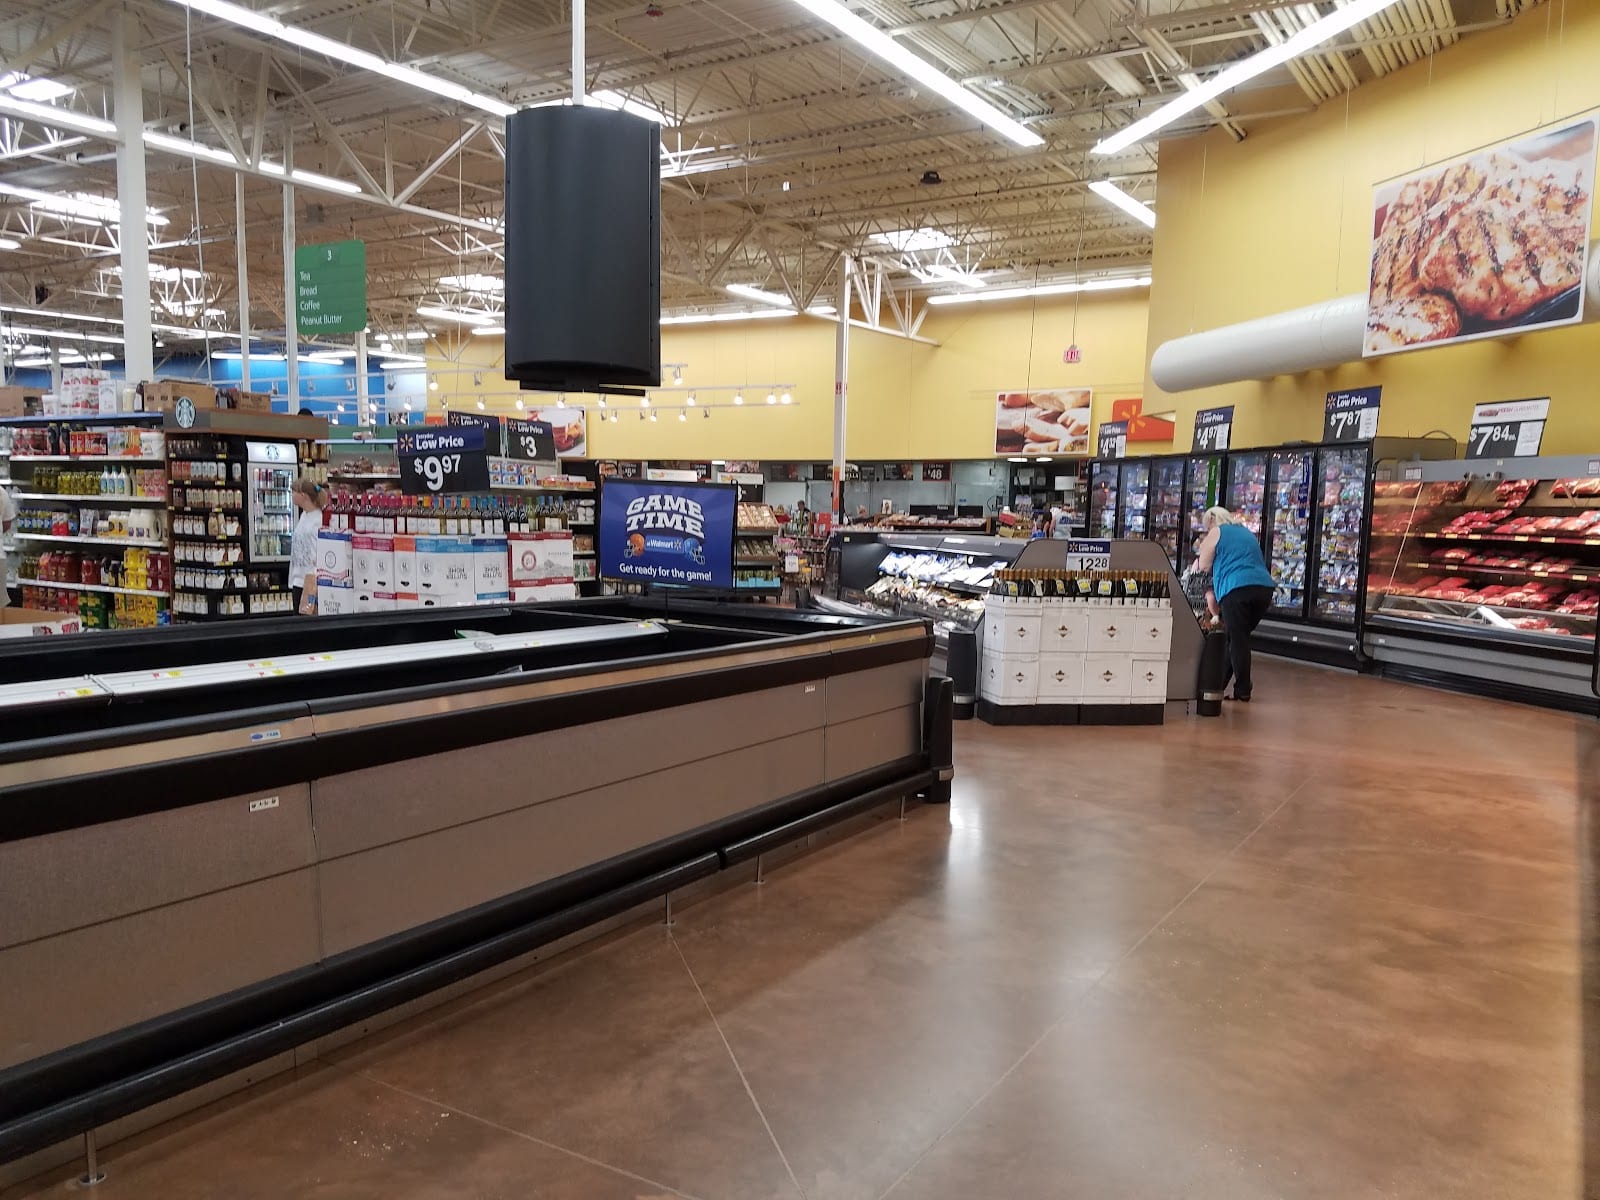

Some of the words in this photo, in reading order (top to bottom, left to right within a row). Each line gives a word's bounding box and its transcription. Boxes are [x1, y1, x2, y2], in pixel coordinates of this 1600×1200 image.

[327, 249, 332, 261] 3
[300, 271, 311, 281] Tea
[300, 285, 318, 297] Bread
[300, 299, 320, 311] Coffee
[301, 315, 322, 326] Peanut
[323, 313, 342, 324] Butter
[1337, 398, 1350, 408] Low
[1351, 395, 1368, 406] Price
[517, 422, 530, 432] Low
[530, 425, 543, 434] Price
[416, 438, 437, 451] Low
[438, 435, 465, 449] Price
[520, 435, 537, 458] $3
[626, 494, 705, 521] GAME
[626, 512, 705, 539] TIME
[651, 539, 674, 549] Walmart
[619, 562, 634, 573] Get
[635, 566, 657, 577] ready
[658, 565, 670, 577] for
[671, 568, 685, 579] the
[686, 570, 712, 581] game!
